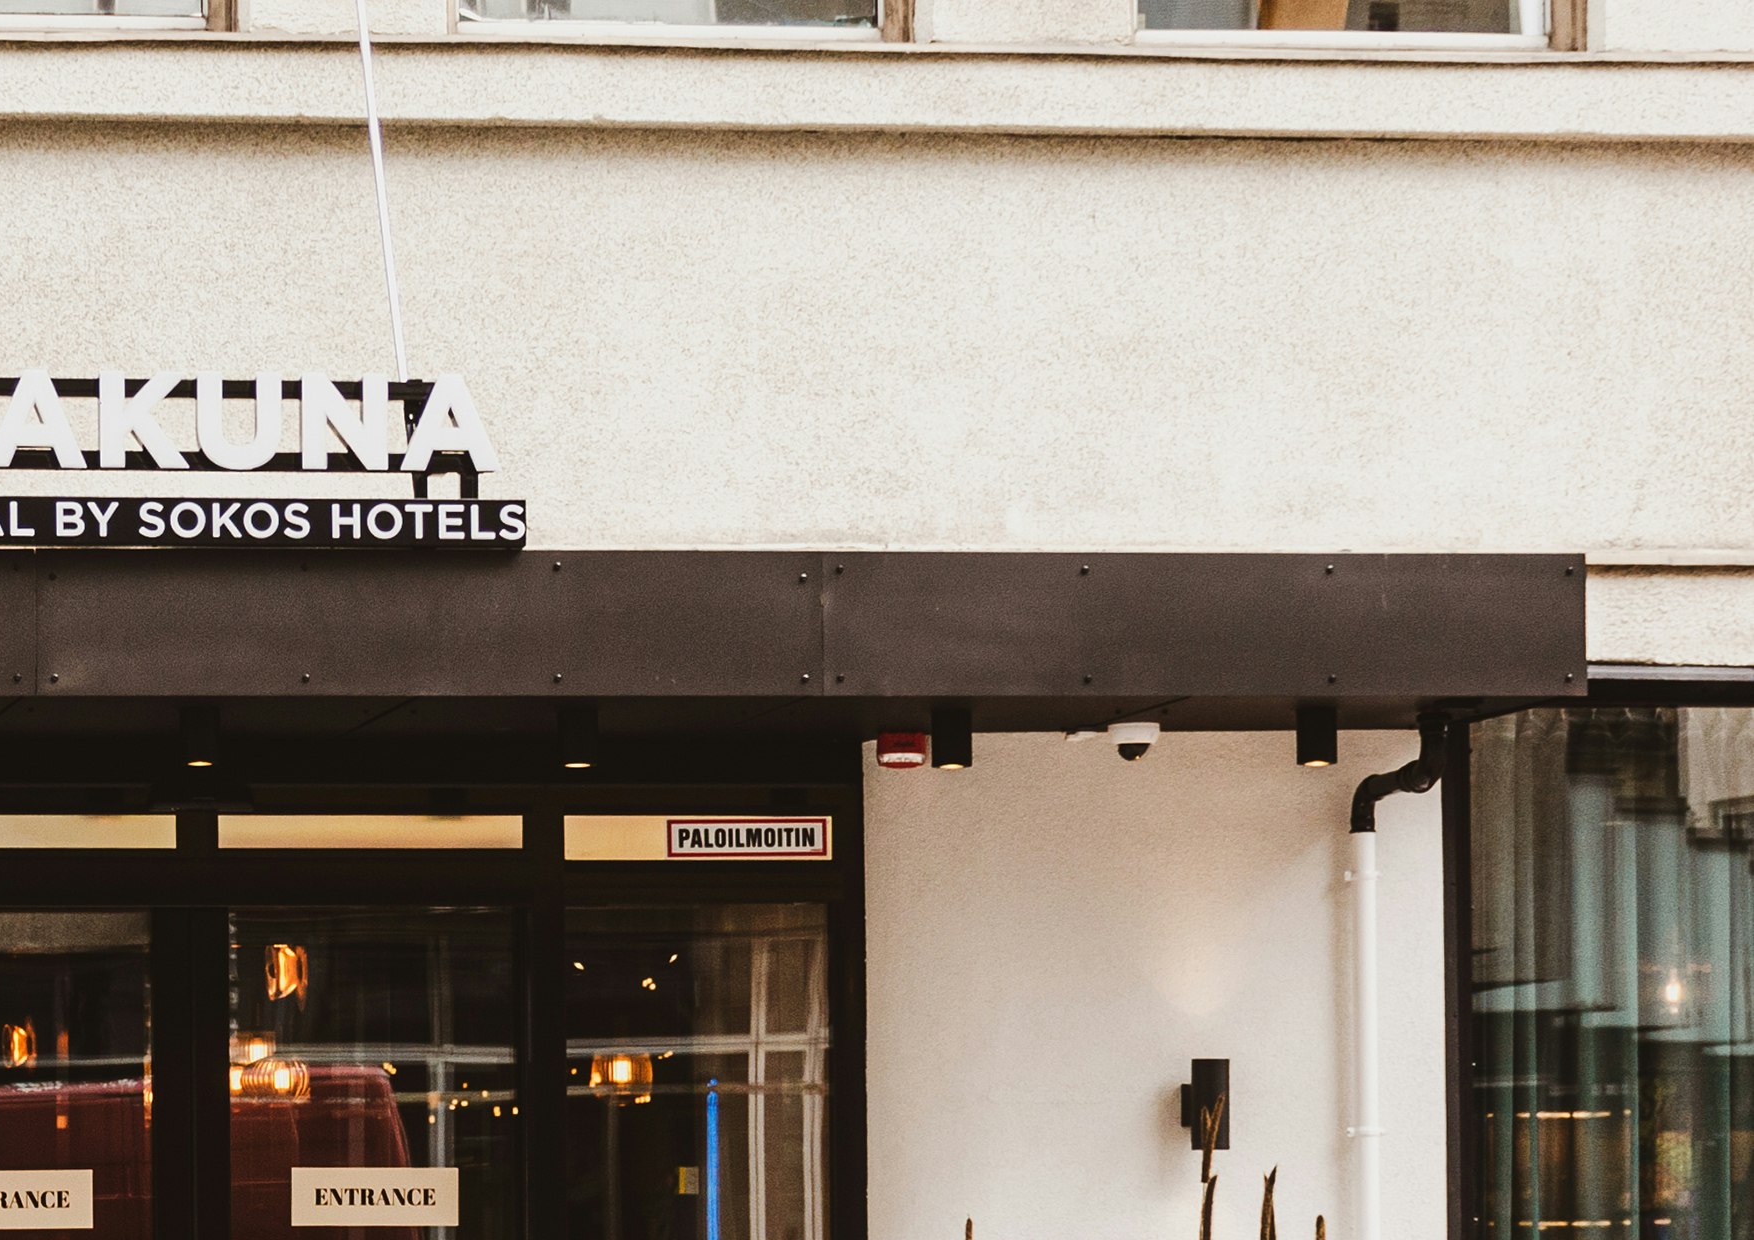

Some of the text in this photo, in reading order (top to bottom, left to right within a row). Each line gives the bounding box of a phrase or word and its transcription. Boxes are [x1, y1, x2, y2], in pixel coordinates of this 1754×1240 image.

[55, 501, 119, 537] BY
[138, 501, 311, 539] SOKOS
[331, 503, 526, 541] HOTELS
[677, 827, 815, 849] PALOILMOITIN
[315, 1187, 436, 1206] ENTRANCE
